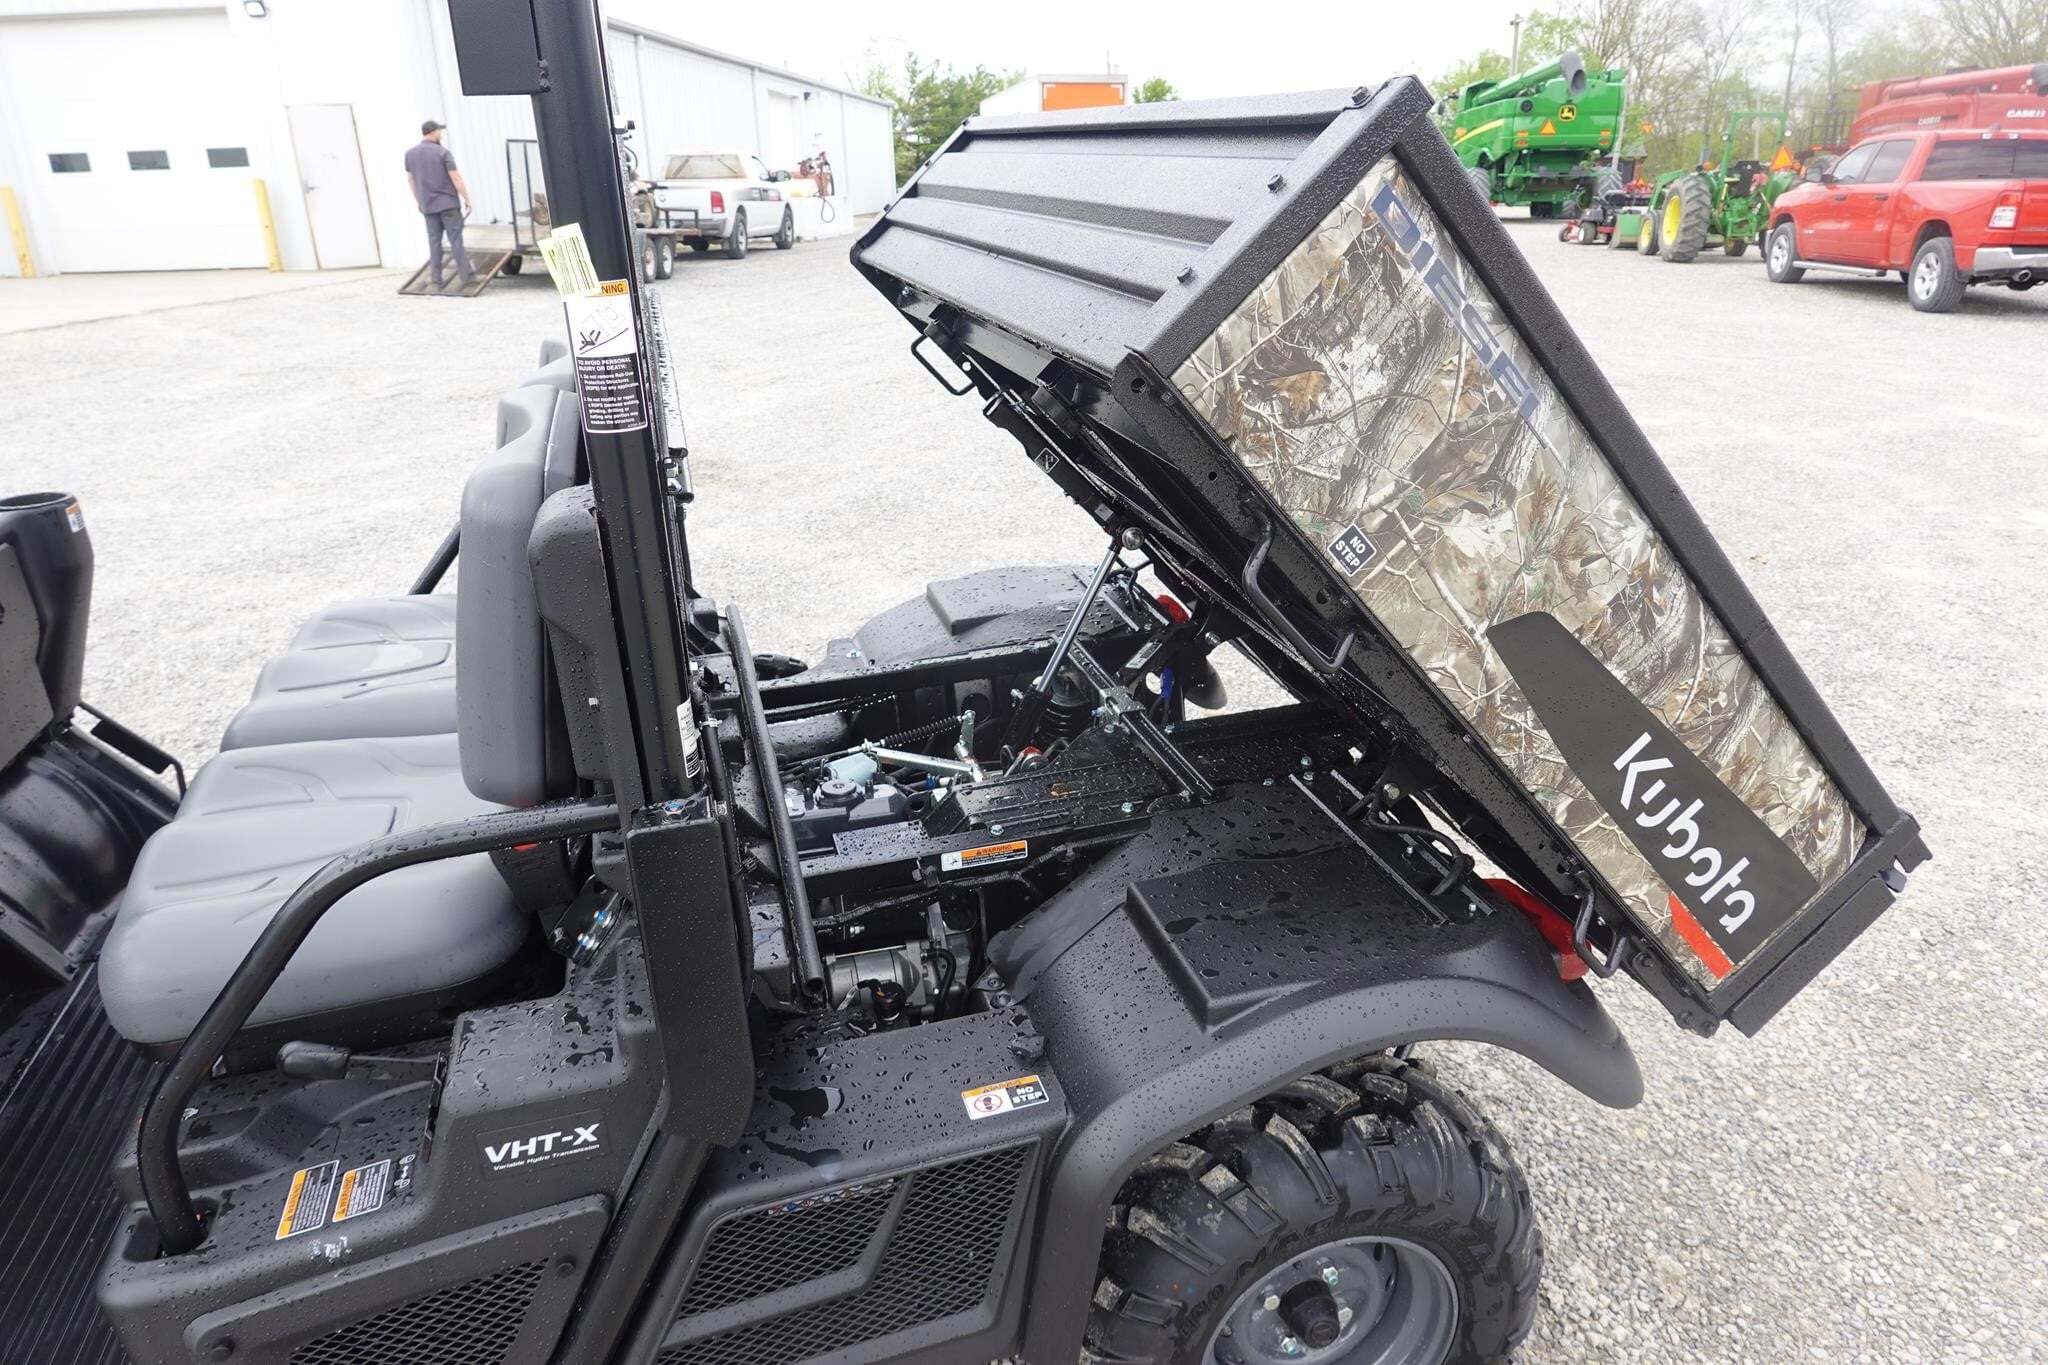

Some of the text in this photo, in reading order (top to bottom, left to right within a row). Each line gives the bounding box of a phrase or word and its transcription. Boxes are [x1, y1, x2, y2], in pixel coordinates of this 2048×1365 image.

[601, 283, 624, 294] NING
[602, 357, 631, 365] PERSONAL
[1350, 536, 1366, 554] NO
[1335, 540, 1360, 566] STEP
[1613, 731, 1756, 934] Kubota
[1012, 1091, 1043, 1104] STEP
[1016, 1086, 1034, 1095] NO
[484, 1123, 600, 1163] VHT-X
